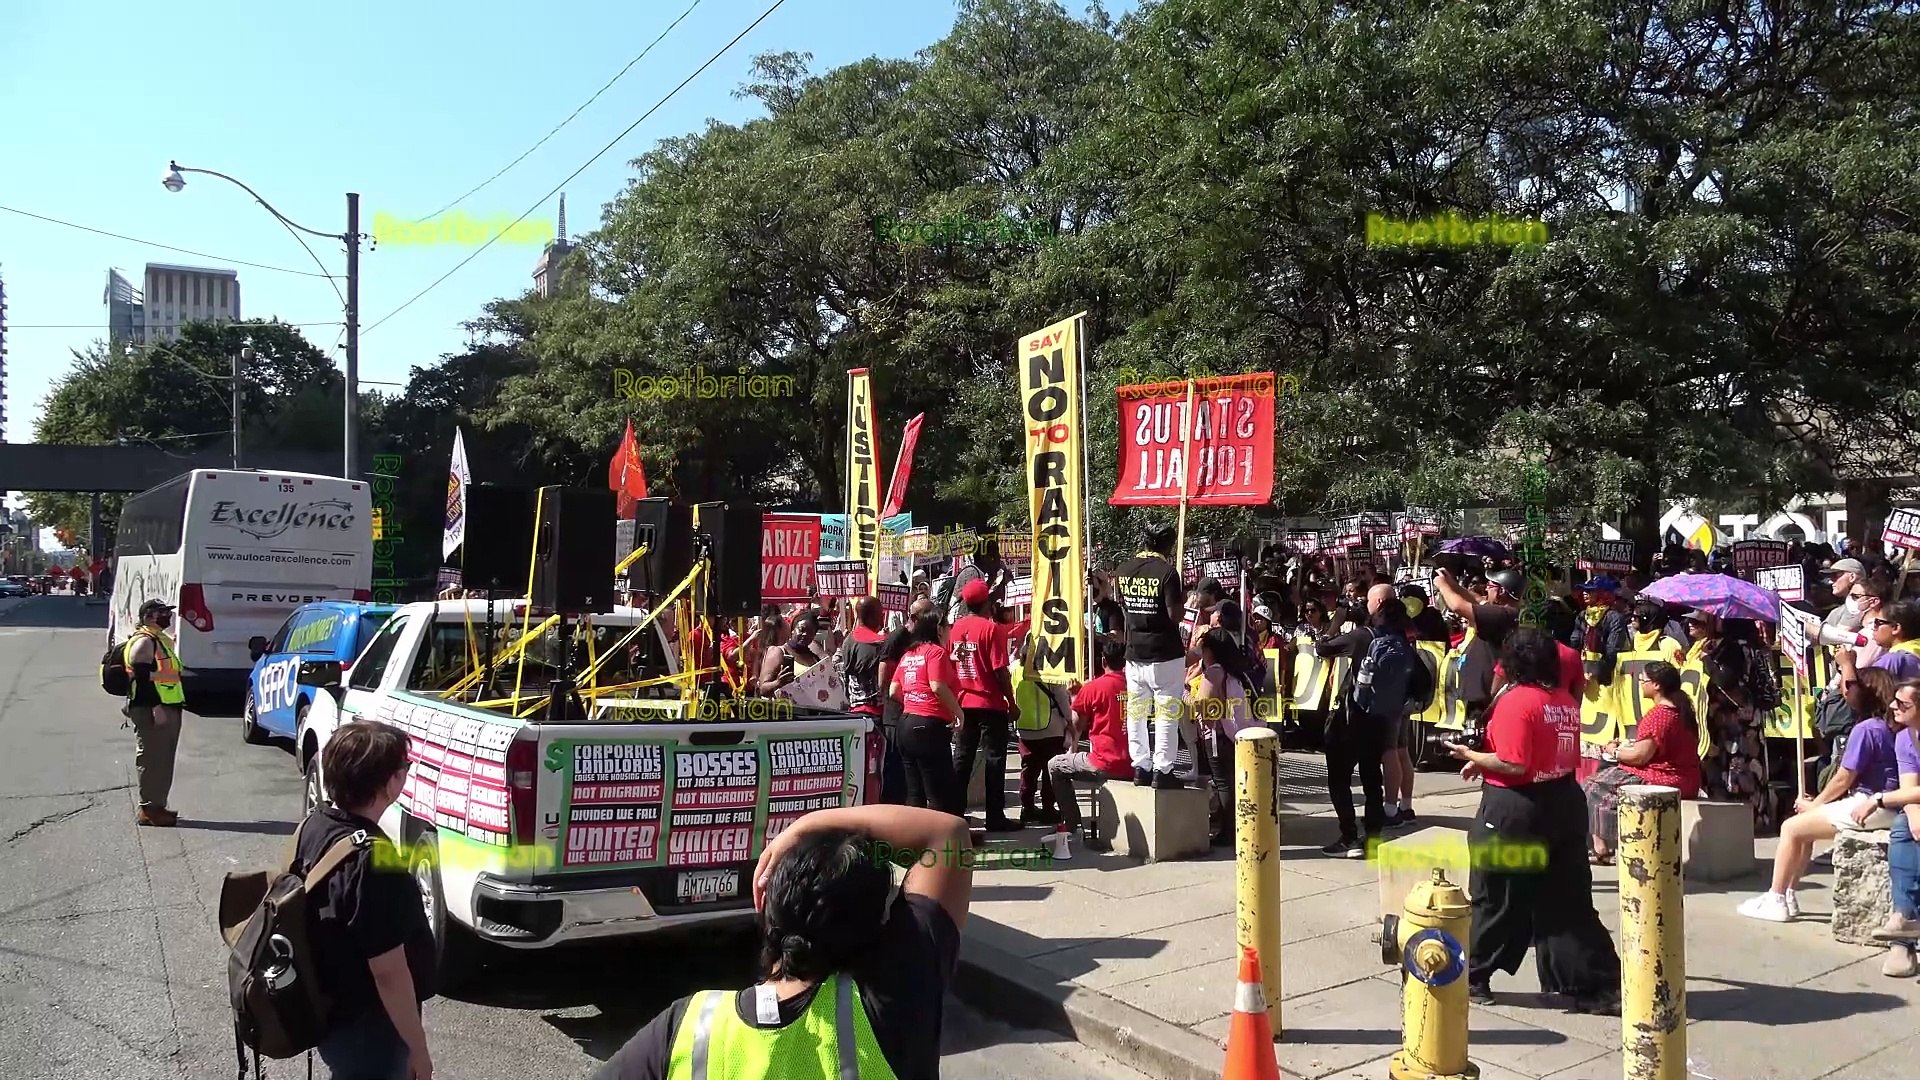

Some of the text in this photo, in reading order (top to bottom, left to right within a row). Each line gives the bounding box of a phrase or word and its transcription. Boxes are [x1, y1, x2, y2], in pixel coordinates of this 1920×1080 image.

[1029, 331, 1063, 352] SAY
[1028, 348, 1068, 422] NO
[1030, 424, 1069, 446] TO
[854, 379, 876, 560] JUSTICE
[278, 484, 295, 493] 135
[210, 500, 355, 531] Excellence
[1893, 511, 1920, 526] GRO
[762, 528, 813, 558] ARIZE
[208, 552, 351, 566] www.autocarexcellence.com
[1033, 450, 1076, 673] RACISM
[762, 563, 811, 589] YONE
[818, 573, 865, 588] UNITED
[1132, 577, 1146, 586] NO
[1147, 578, 1160, 587] TO
[232, 593, 326, 604] PREVOST
[258, 656, 300, 715] SEFPO
[574, 744, 661, 760] CORPORATE
[770, 738, 841, 756] CORPORATE
[574, 758, 661, 774] LANDLORDS
[676, 751, 757, 778] BOSSES
[771, 752, 843, 769] LANDLORDS
[574, 772, 661, 782] CAUSE THE HOUSING CRISIS
[772, 768, 789, 776] CAUSE
[802, 765, 826, 774] HOUSING
[827, 764, 843, 772] CRISIS
[677, 776, 756, 788] CUT JOBS & WAGES
[771, 776, 842, 793] NOT MIGRANTS
[573, 785, 660, 800] NOT MIGRANTS
[675, 790, 755, 805] NOT MIGRANTS
[769, 796, 840, 813] DIVIDED WE FALL
[571, 807, 658, 821] DIVIDED WE FALL
[673, 811, 752, 826] DIVIDED WE FALL
[568, 826, 656, 850] UNITED
[670, 828, 750, 853] UNITED
[567, 848, 653, 864] WE WIN FOR ALL
[669, 850, 748, 865] WE WIN FOR ALL
[683, 875, 733, 897] AM74766
